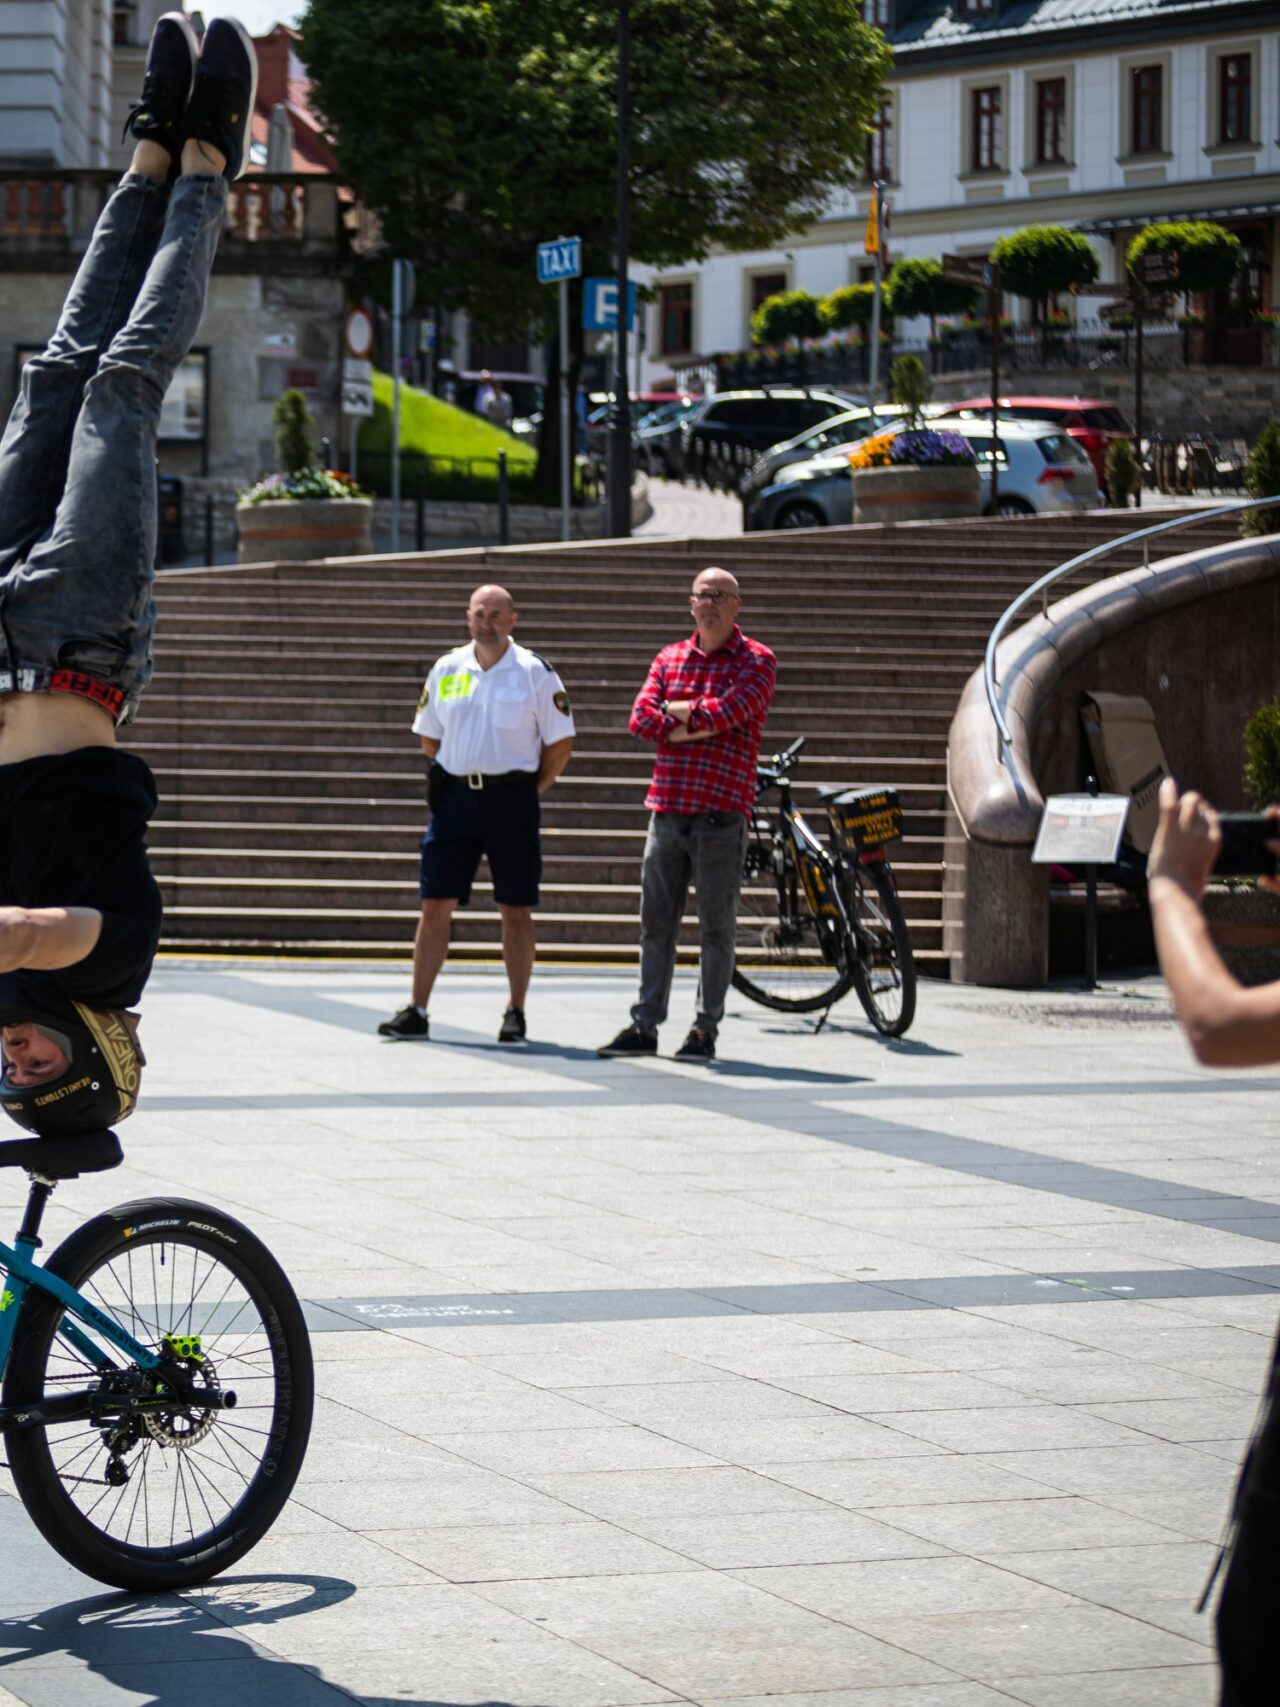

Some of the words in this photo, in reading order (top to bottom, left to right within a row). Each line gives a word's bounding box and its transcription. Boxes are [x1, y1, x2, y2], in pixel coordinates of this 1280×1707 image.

[138, 1219, 182, 1231] MICHELIN
[187, 1220, 219, 1234] PILOT
[269, 1324, 292, 1409] INDUSTRY
[268, 1415, 290, 1455] NINE
